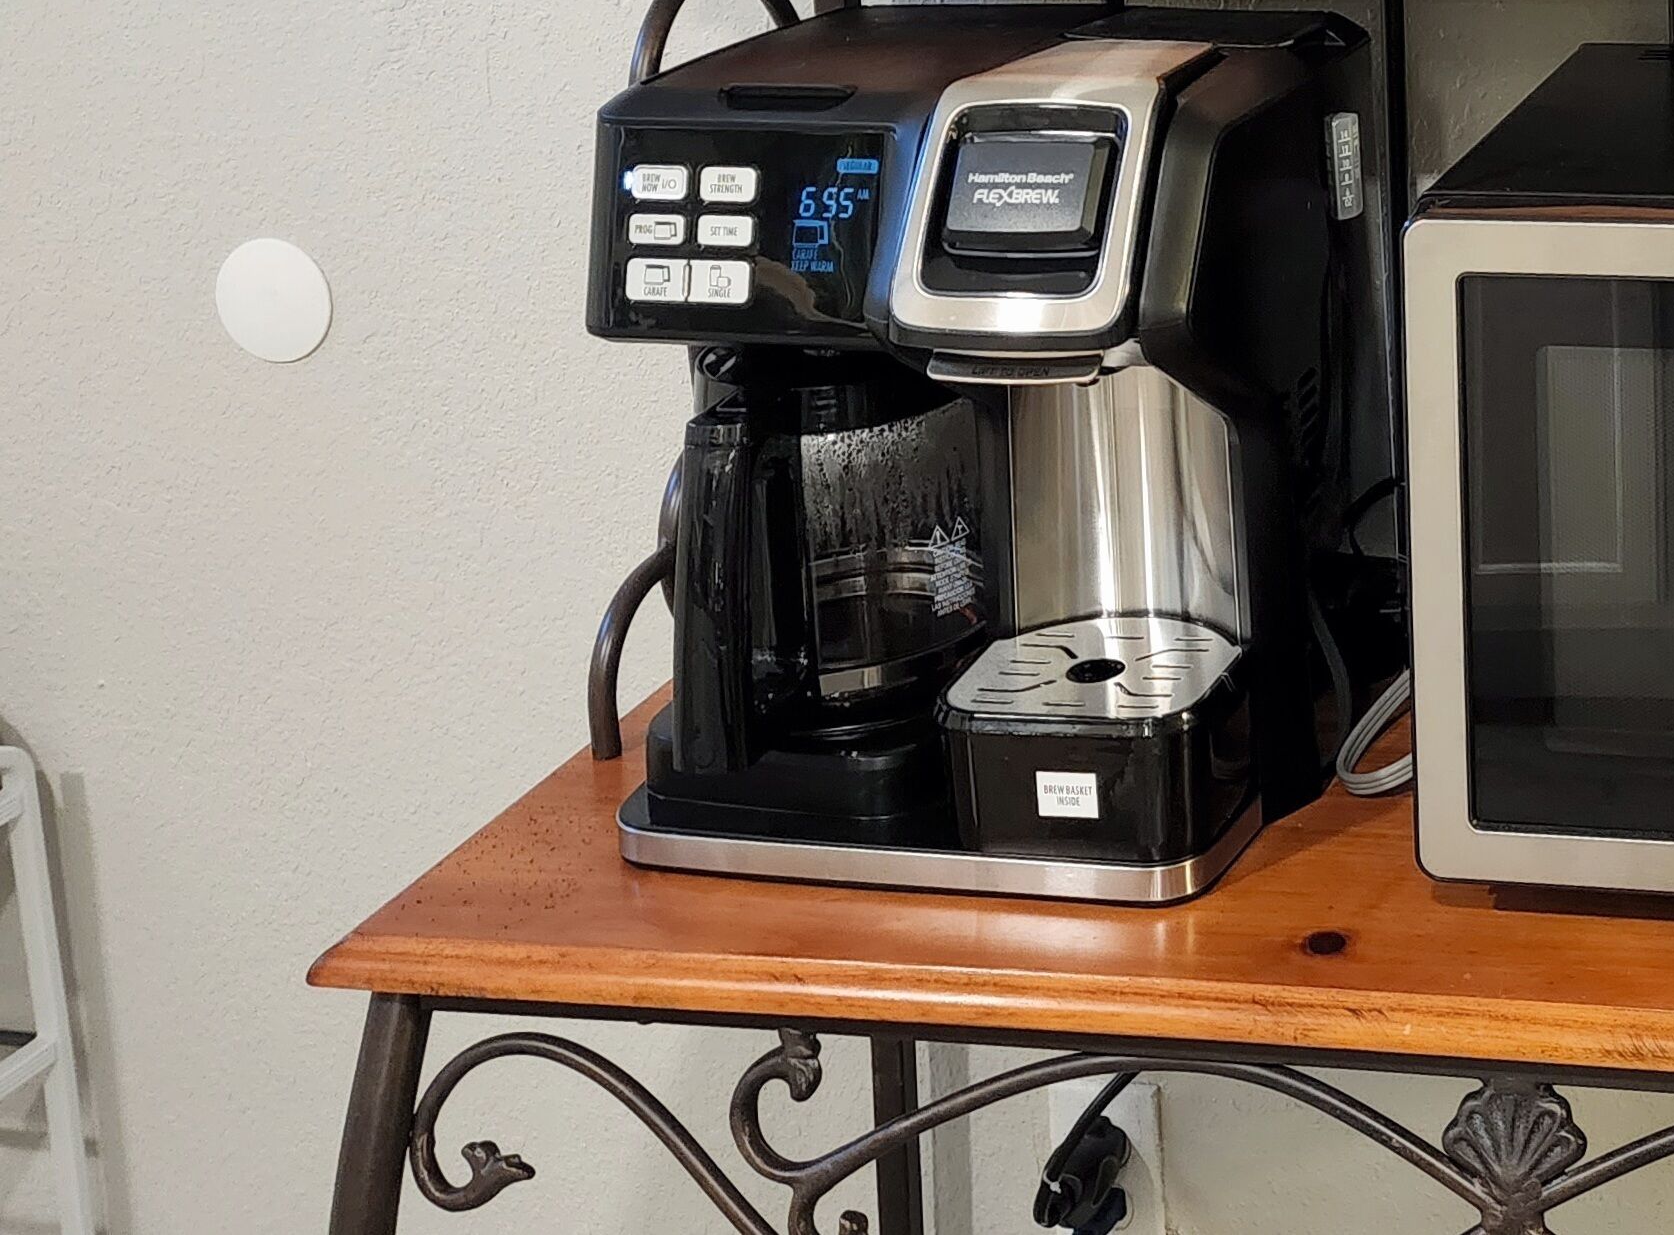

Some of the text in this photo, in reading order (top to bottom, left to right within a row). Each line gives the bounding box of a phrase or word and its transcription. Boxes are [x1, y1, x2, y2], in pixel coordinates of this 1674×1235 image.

[641, 173, 661, 183] BREW
[716, 173, 736, 183] BREW
[967, 172, 1027, 184] Hamilton
[641, 183, 658, 193] NOW
[709, 183, 743, 194] STRENGTH
[634, 224, 653, 234] PROG
[709, 226, 738, 237] SET TIME
[643, 286, 668, 297] CARAFE
[707, 287, 731, 298] SINGLE
[971, 365, 1050, 377] LIFT TO OPEN
[1043, 784, 1092, 796] BREW BASKET
[1056, 796, 1081, 806] INSIDE
